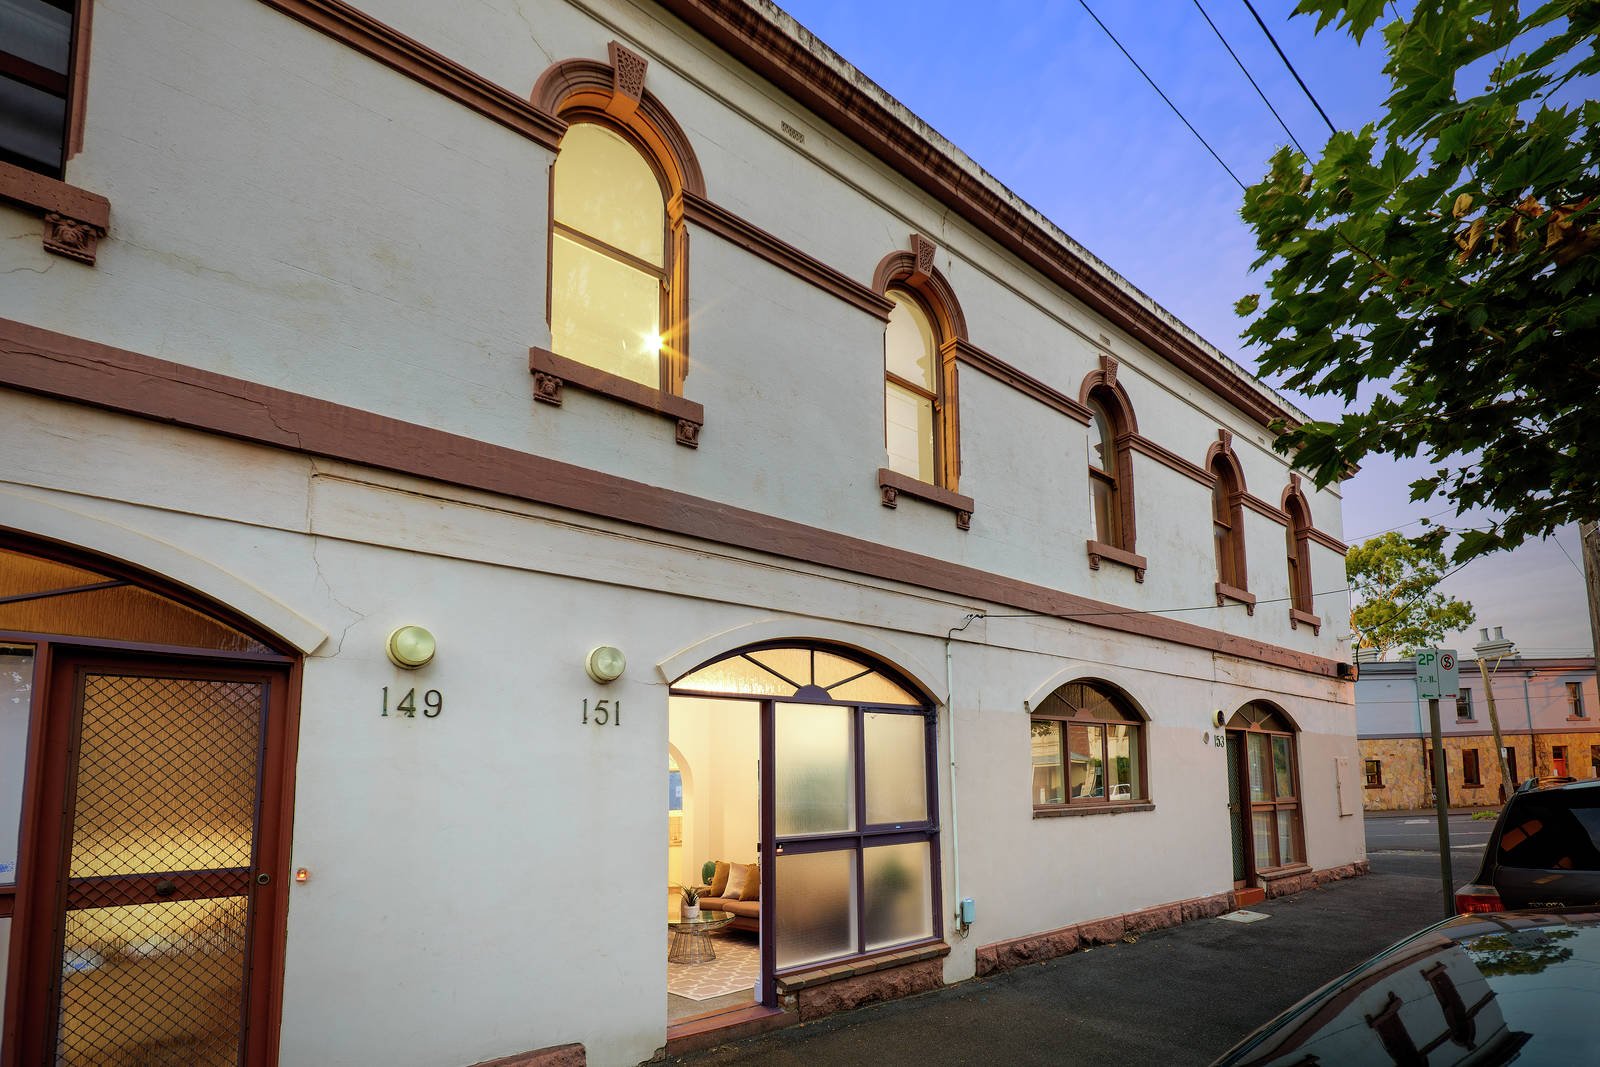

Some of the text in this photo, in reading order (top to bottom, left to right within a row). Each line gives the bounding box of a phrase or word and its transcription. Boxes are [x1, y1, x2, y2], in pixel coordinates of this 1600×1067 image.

[1418, 653, 1434, 666] 2P
[378, 686, 443, 718] 149
[581, 698, 620, 726] 151
[1213, 735, 1225, 748] 153
